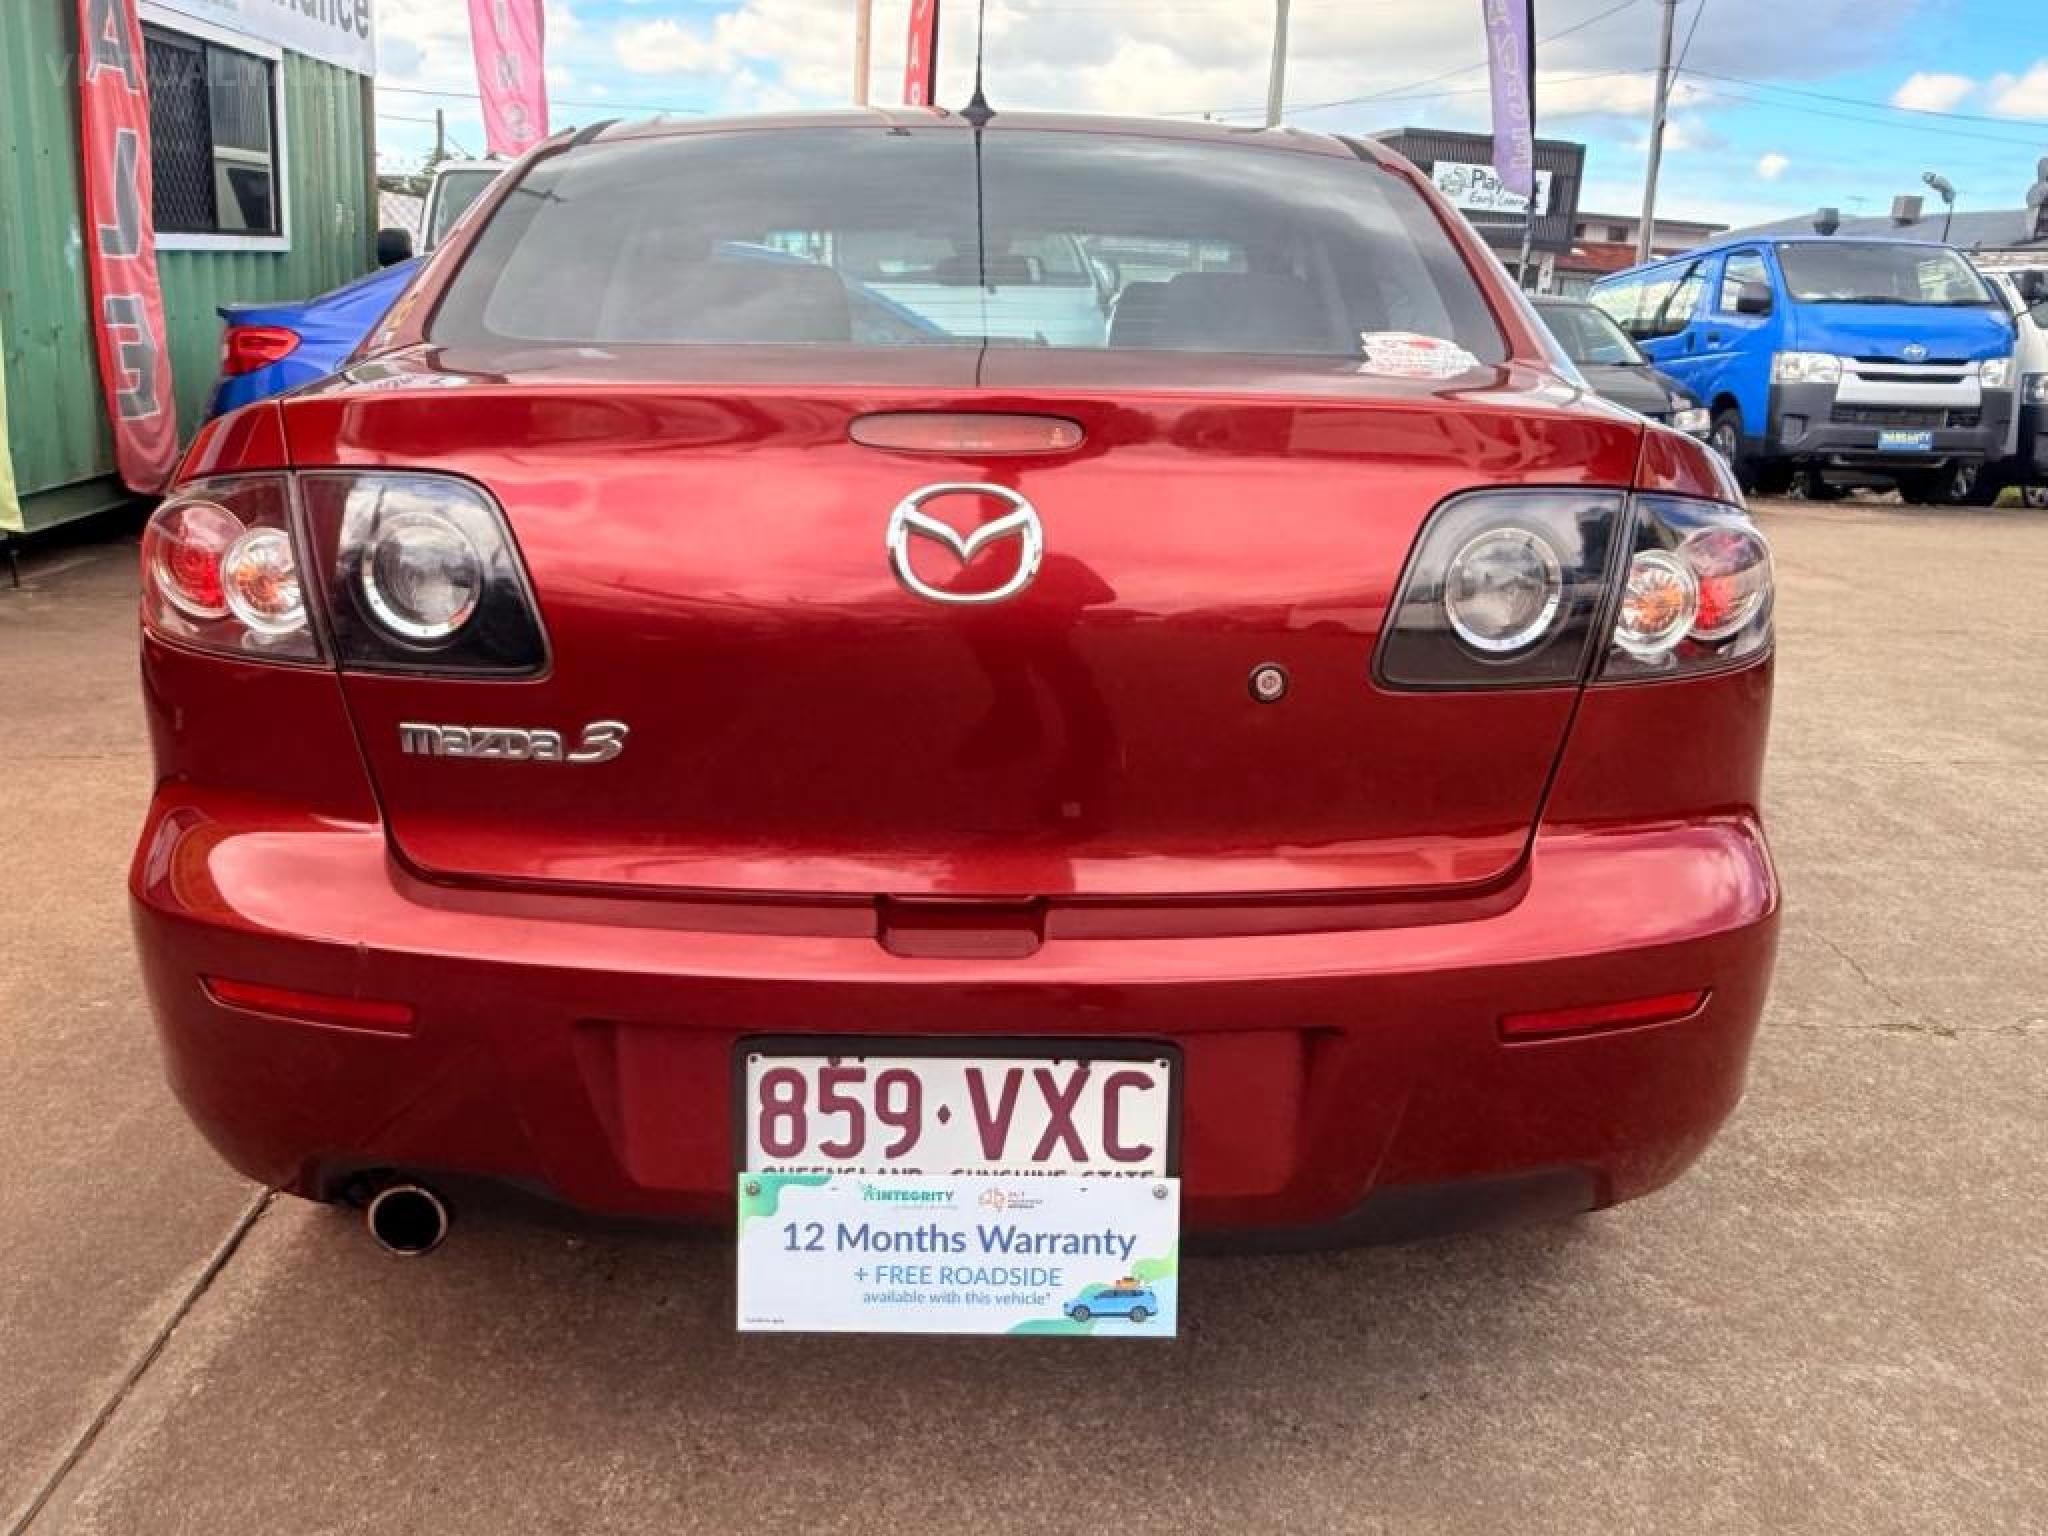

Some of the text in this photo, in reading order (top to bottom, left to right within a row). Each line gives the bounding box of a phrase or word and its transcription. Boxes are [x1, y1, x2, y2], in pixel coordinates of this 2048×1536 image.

[566, 720, 630, 763] 3
[877, 1190, 954, 1202] INTEGRITY
[783, 1223, 1137, 1261] 12 Months Warranty
[875, 1265, 932, 1285] FREE
[939, 1266, 1063, 1287] ROADSIDE
[863, 1290, 924, 1305] available
[929, 1290, 960, 1305] with
[965, 1291, 991, 1305] this
